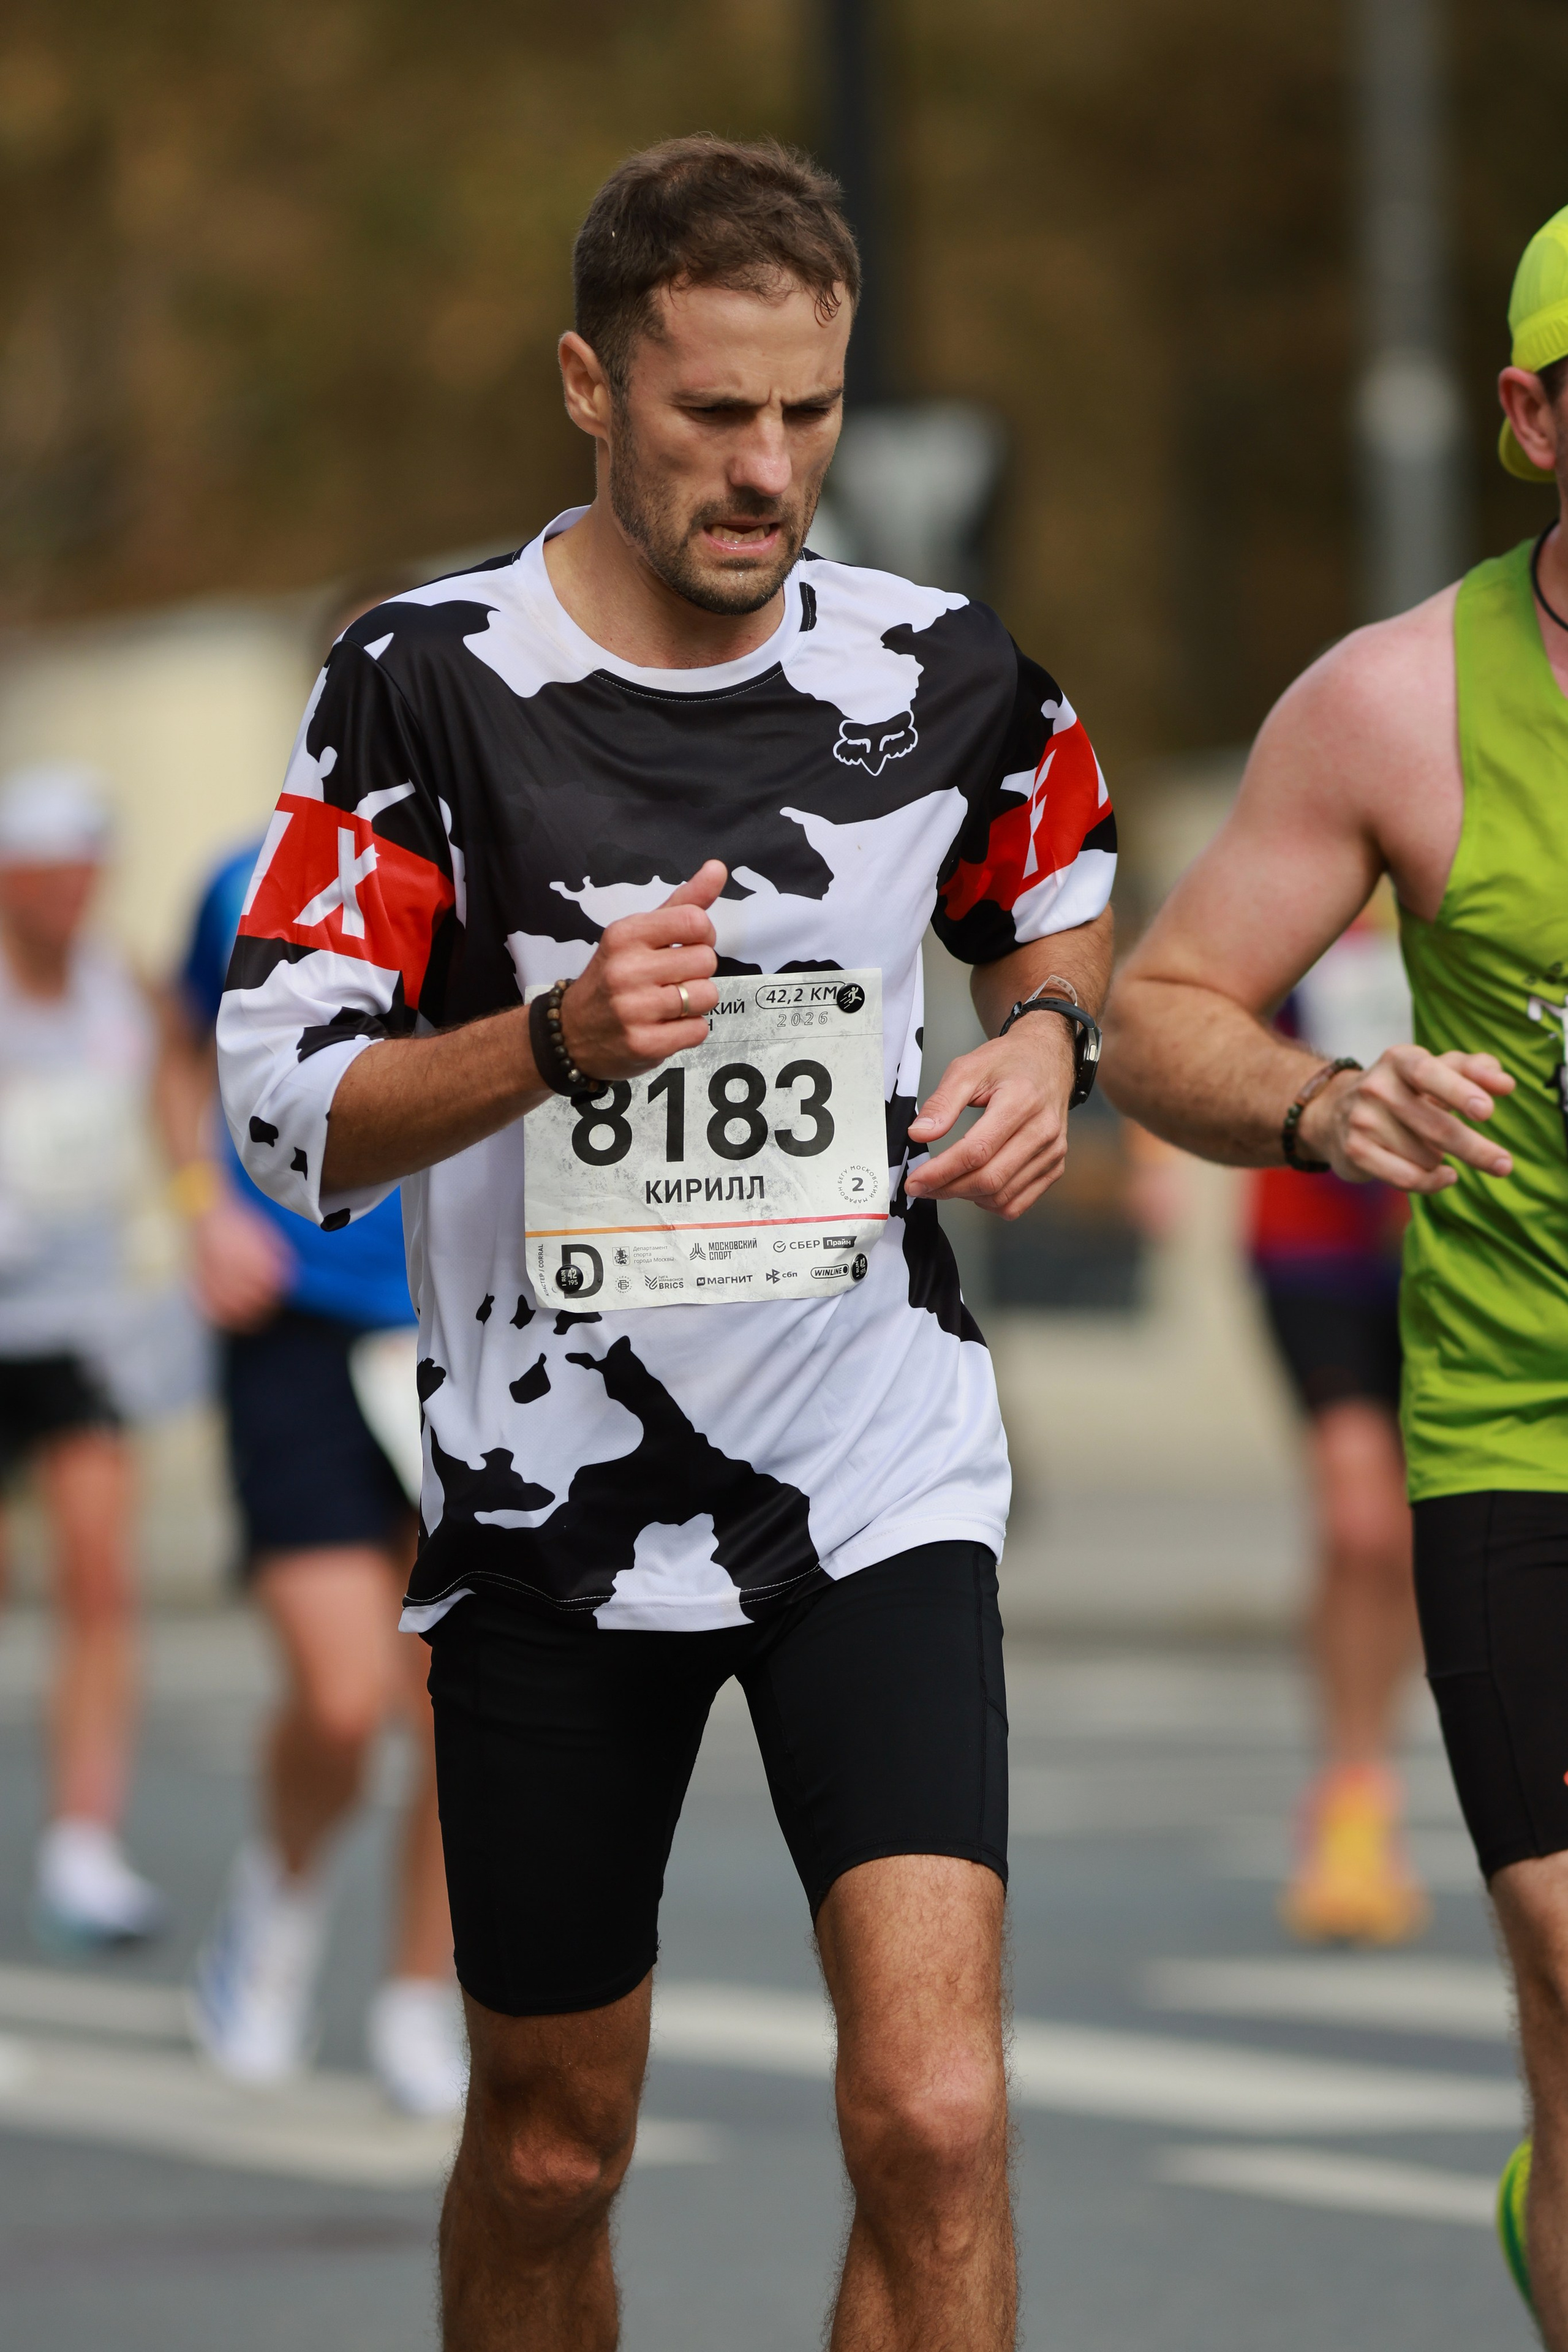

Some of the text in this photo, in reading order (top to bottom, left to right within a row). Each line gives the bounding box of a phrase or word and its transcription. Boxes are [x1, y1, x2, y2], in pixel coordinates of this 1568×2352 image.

[766, 988, 804, 1005] 42,2
[777, 1011, 828, 1027] 2026
[571, 1059, 835, 1166] 8183
[645, 1175, 765, 1204] КИРИЛЛ
[838, 1165, 878, 1204] БЕГУ МОСКОВСКИЙ МАРАФОН
[852, 1177, 864, 1192] 2
[708, 1237, 758, 1251] МОСКОВСКИЙ
[790, 1240, 820, 1250] СБЕР
[826, 1238, 851, 1248] Прайм
[709, 1250, 732, 1261] СПОРТ
[561, 1243, 604, 1299] D
[568, 1269, 577, 1279] 42
[814, 1267, 843, 1276] WINLINE
